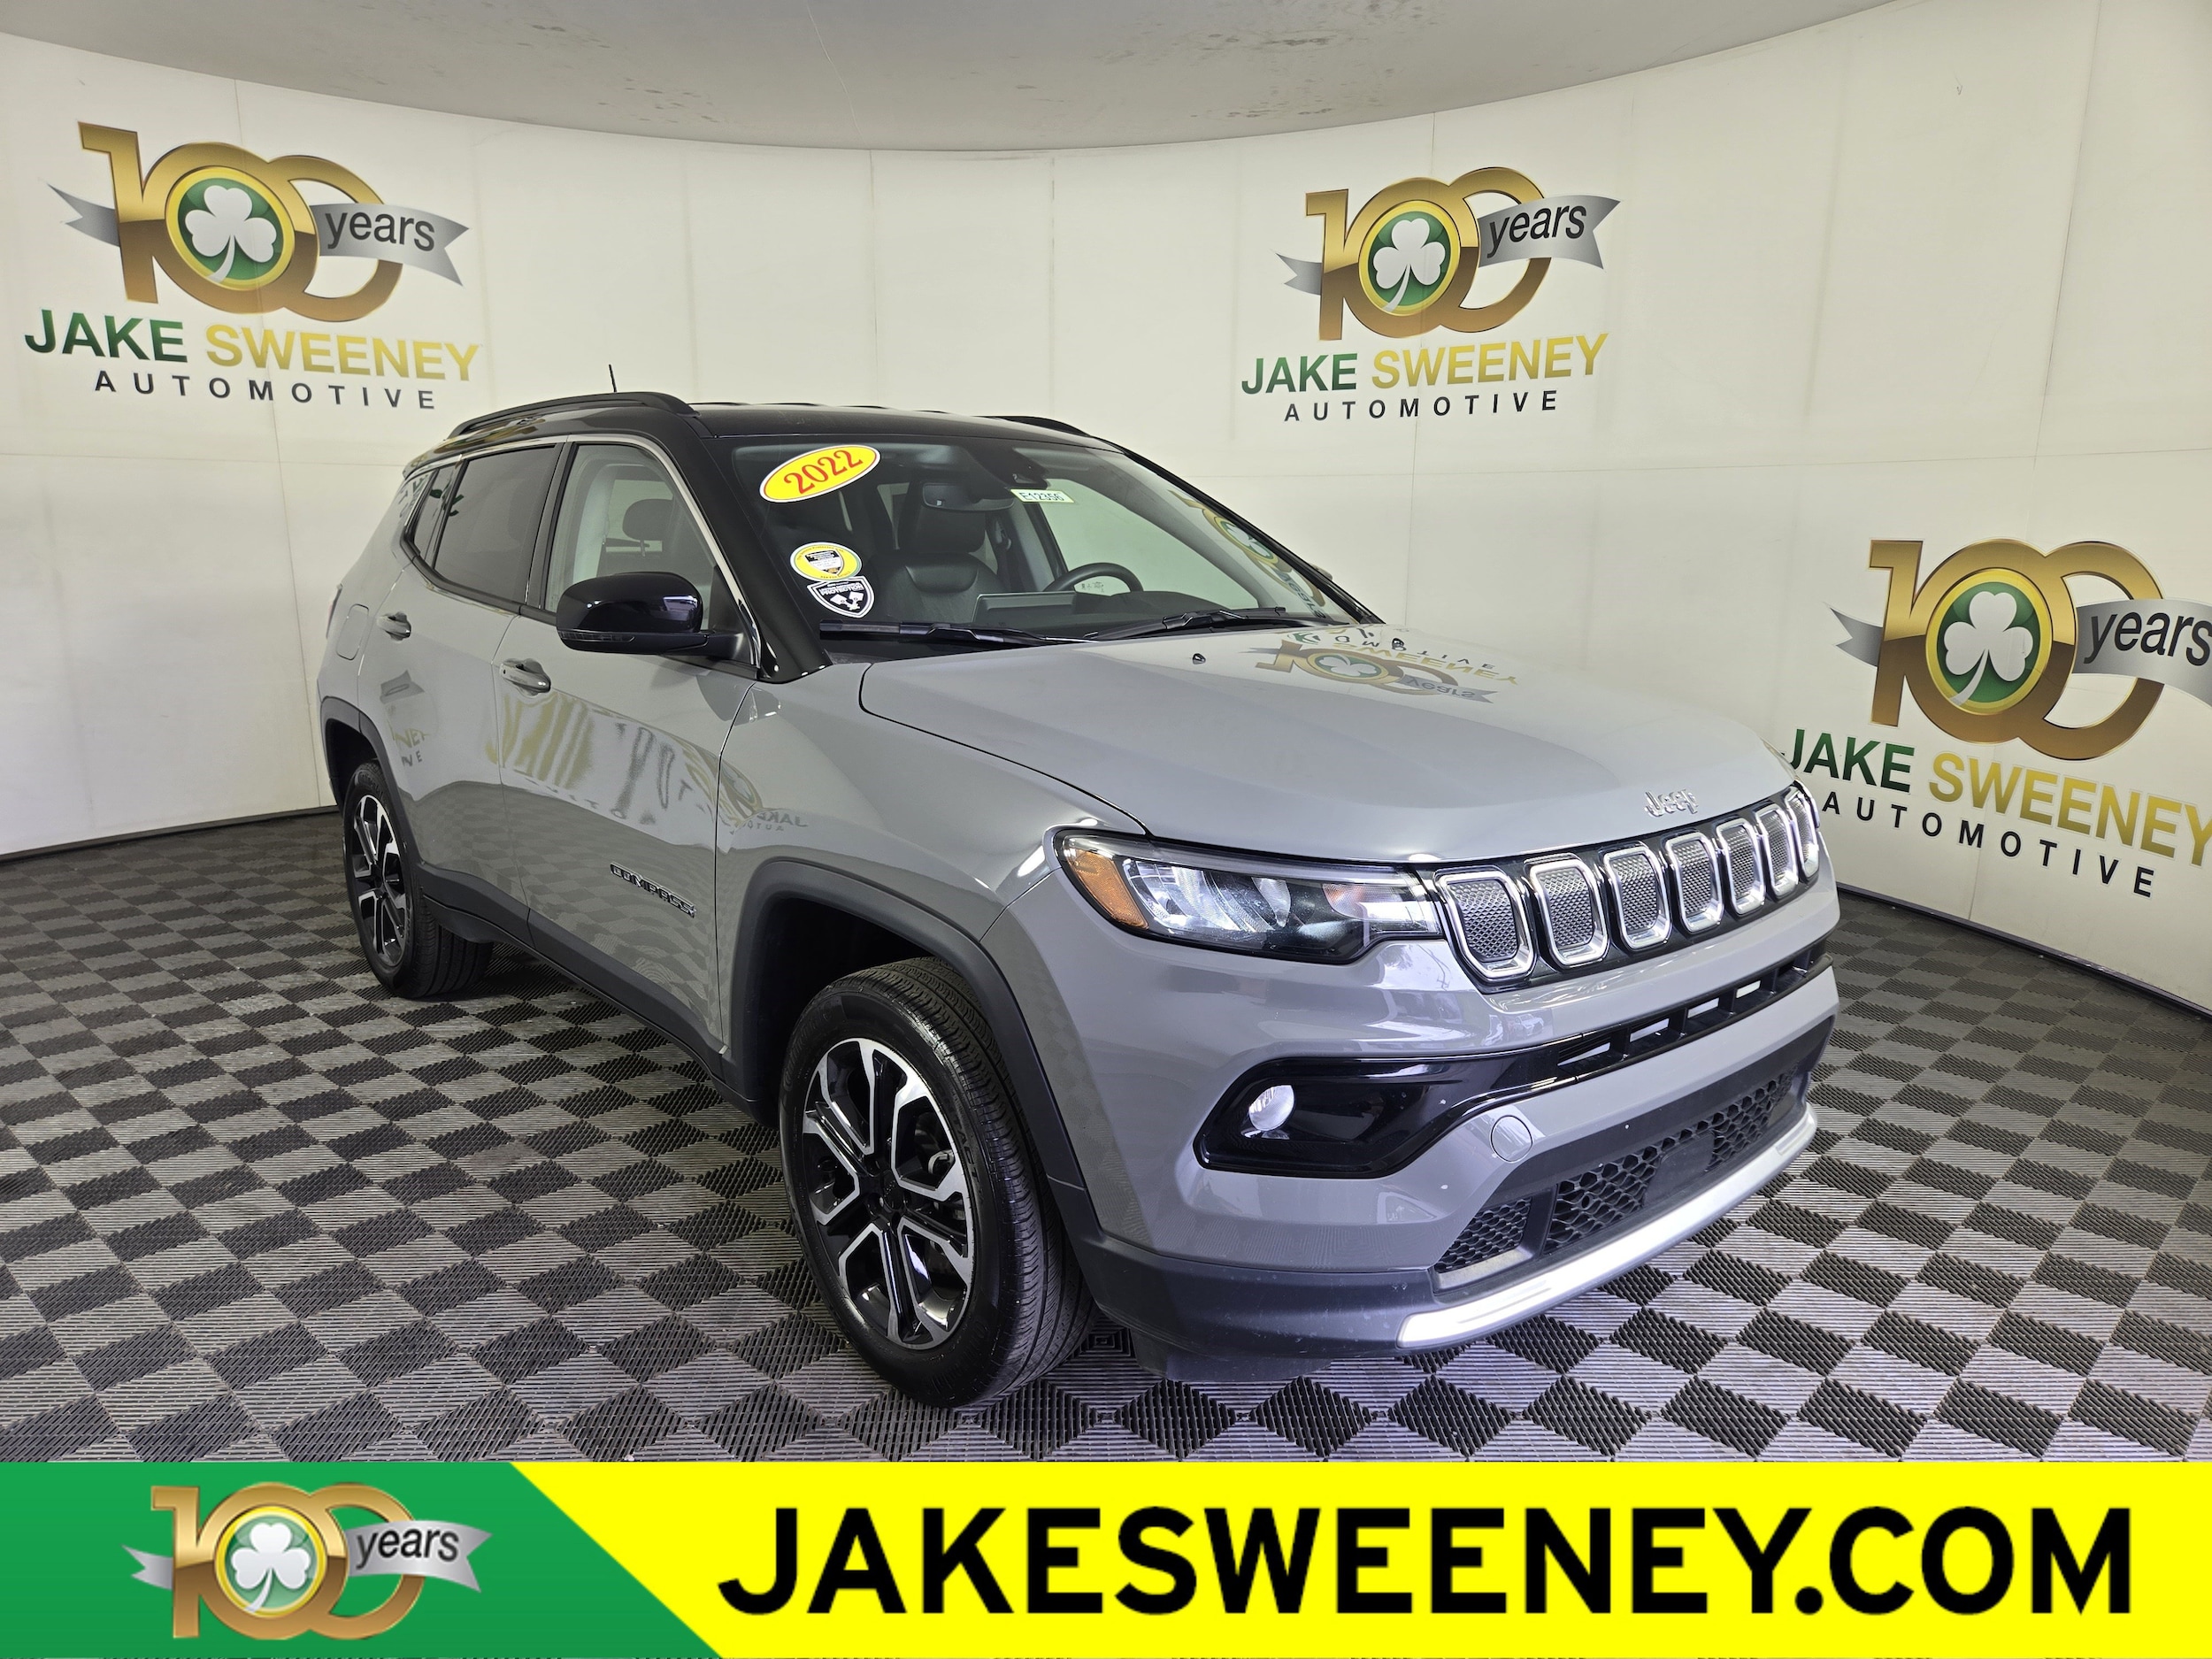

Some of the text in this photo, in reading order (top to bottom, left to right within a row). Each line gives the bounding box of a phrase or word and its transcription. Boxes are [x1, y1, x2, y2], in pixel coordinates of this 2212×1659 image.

[78, 121, 436, 322] 100 years
[1305, 166, 1587, 342] 100 years
[25, 308, 480, 381] JAKE SWEENEY
[1241, 333, 1609, 395] JAKE SWEENEY
[94, 370, 435, 410] AUTOMOTIVE
[1284, 390, 1557, 422] AUTOMOTIVE
[784, 449, 864, 495] 2022
[1868, 538, 2212, 761] 100 years
[1645, 789, 1699, 818] Jeep
[1781, 728, 2212, 867] JAKE SWEENEY
[1822, 791, 2154, 898] AUTOMOTIVE
[610, 861, 697, 918] COMPASS
